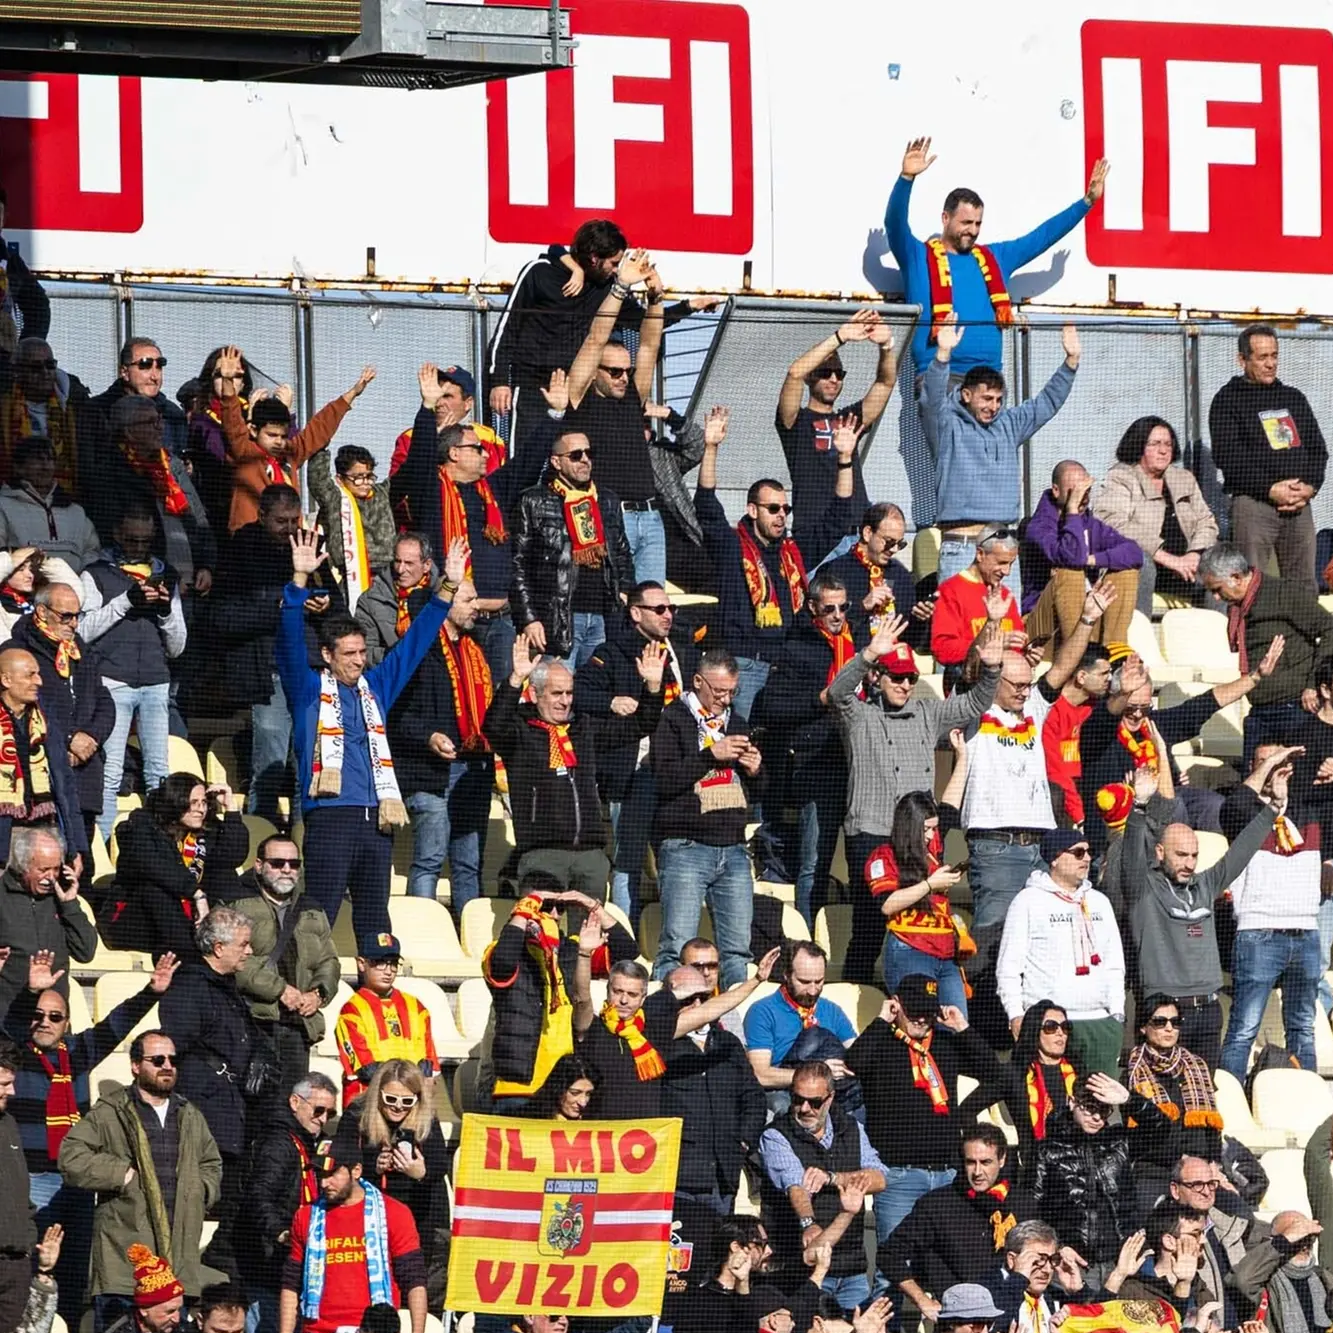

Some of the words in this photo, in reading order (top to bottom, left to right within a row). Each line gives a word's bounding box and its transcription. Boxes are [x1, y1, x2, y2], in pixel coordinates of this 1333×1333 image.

[507, 34, 733, 216] IFI
[1101, 57, 1322, 237] IFI
[484, 1127, 536, 1172] IL
[550, 1128, 658, 1174] MIO
[475, 1259, 639, 1308] VIZIO
